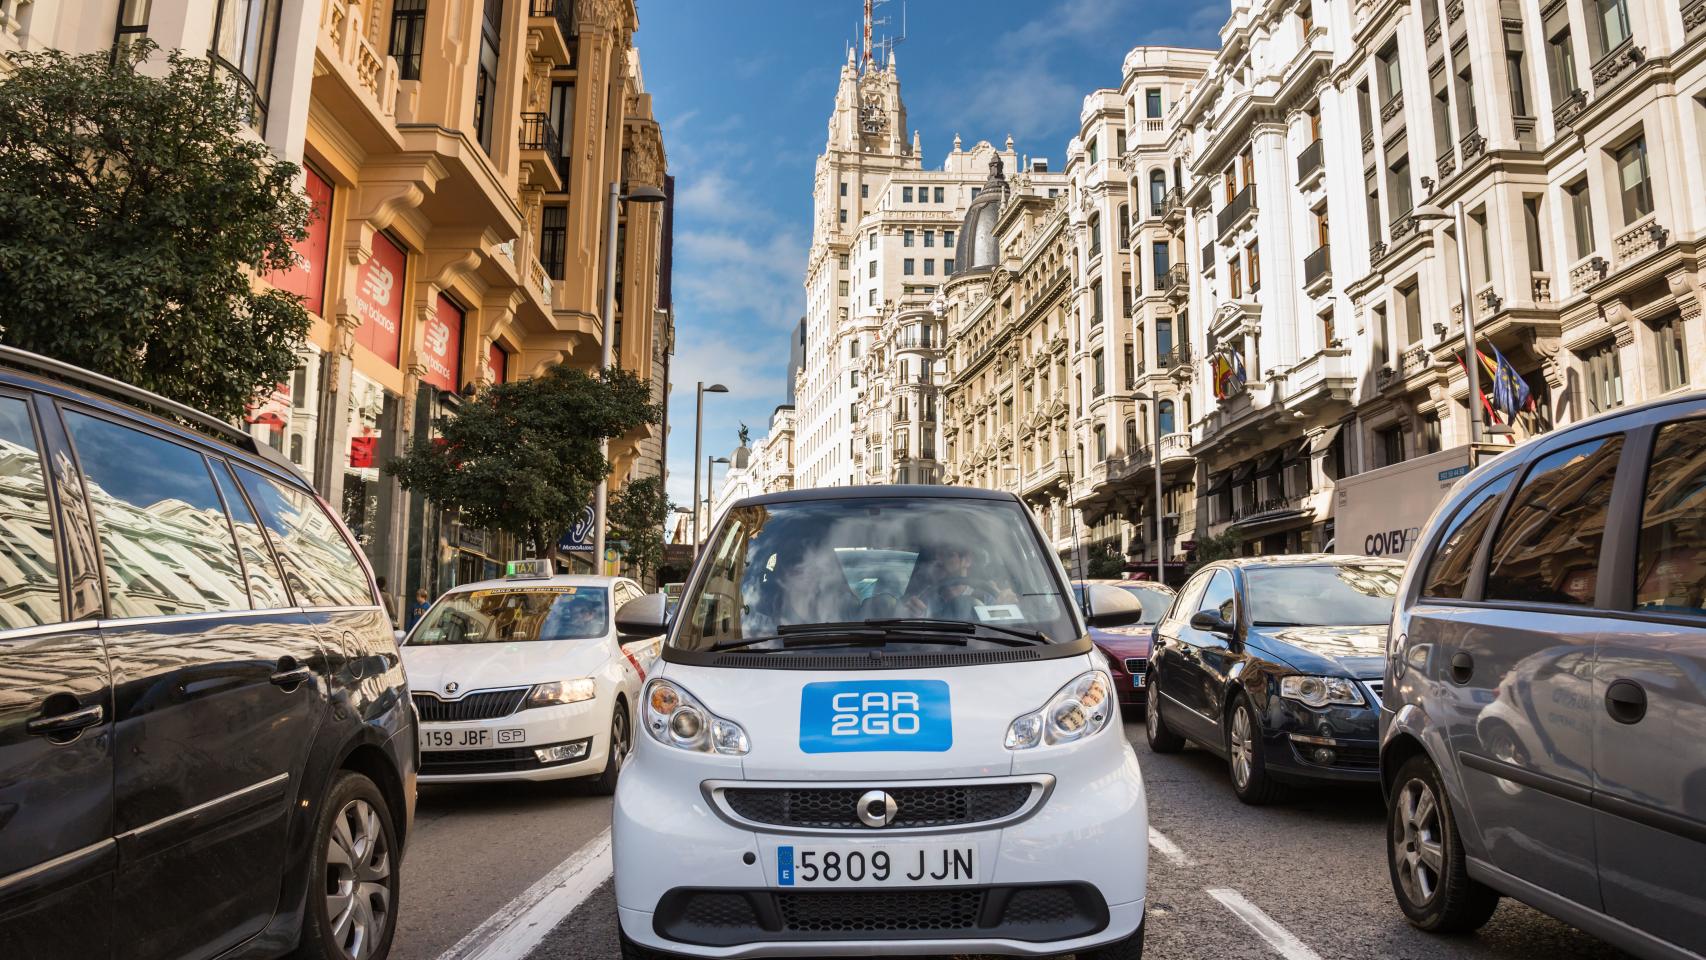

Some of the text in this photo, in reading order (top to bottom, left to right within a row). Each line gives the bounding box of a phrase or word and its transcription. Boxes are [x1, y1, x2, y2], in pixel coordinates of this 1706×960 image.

[367, 303, 395, 334] balance
[516, 562, 536, 574] TAXI
[832, 691, 920, 712] CAR
[831, 712, 920, 736] 2GO
[459, 729, 488, 746] JBF
[501, 730, 522, 742] SP
[783, 848, 973, 882] E 5809 JJN
